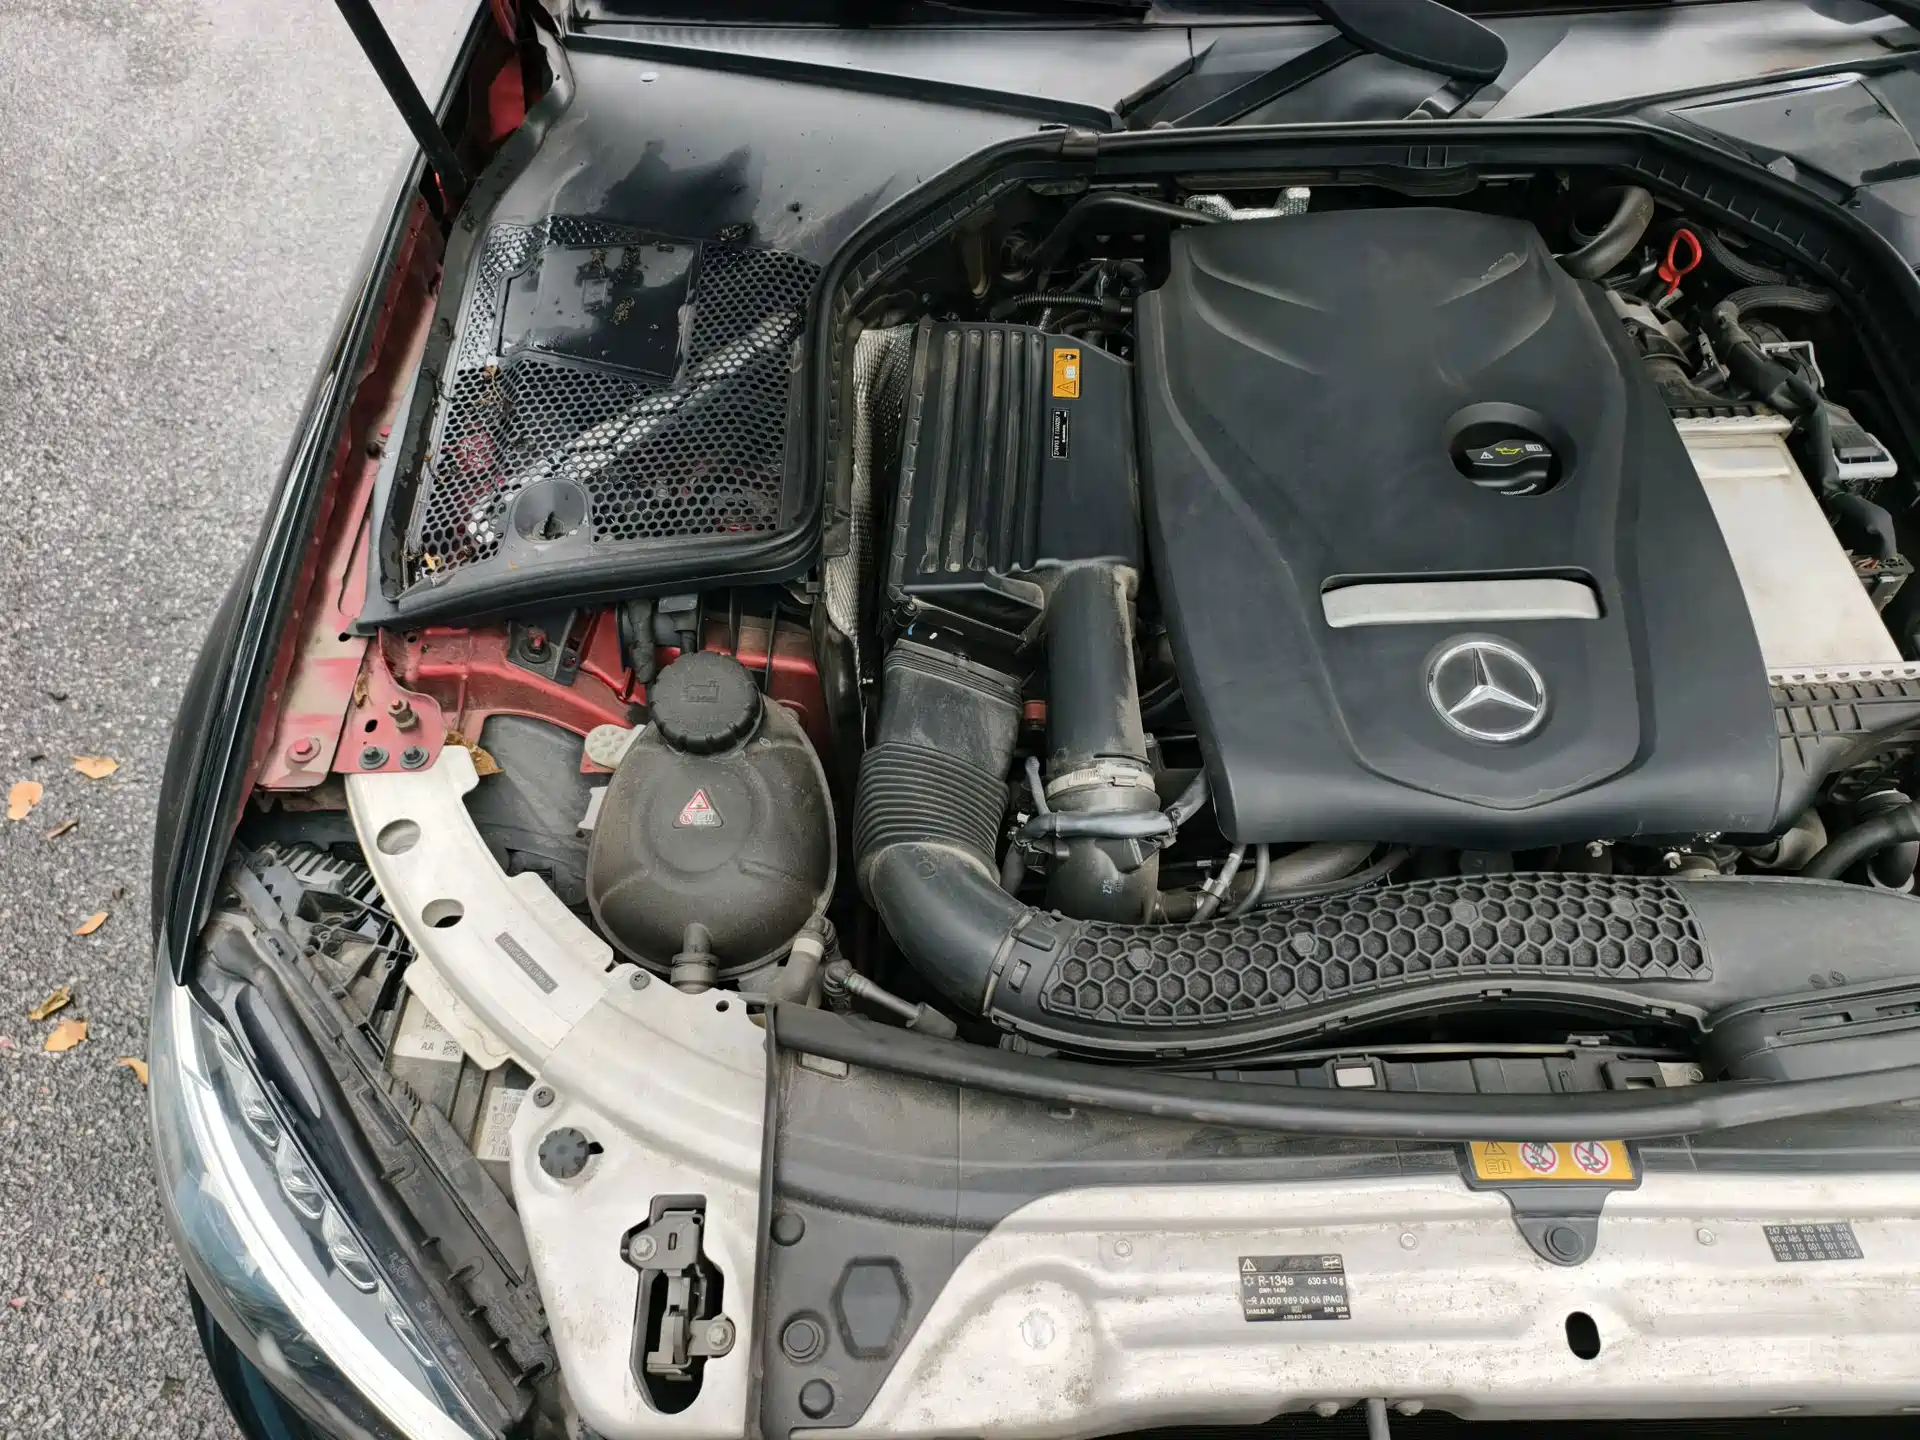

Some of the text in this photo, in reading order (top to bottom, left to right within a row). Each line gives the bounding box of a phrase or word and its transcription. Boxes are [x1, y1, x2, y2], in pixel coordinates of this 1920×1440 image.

[1258, 1275, 1294, 1286] R-134a
[1267, 1297, 1281, 1305] 000
[1284, 1296, 1298, 1304] 989
[1300, 1296, 1310, 1304] 06
[1311, 1296, 1321, 1304] 06
[1323, 1295, 1344, 1305] (PAG)
